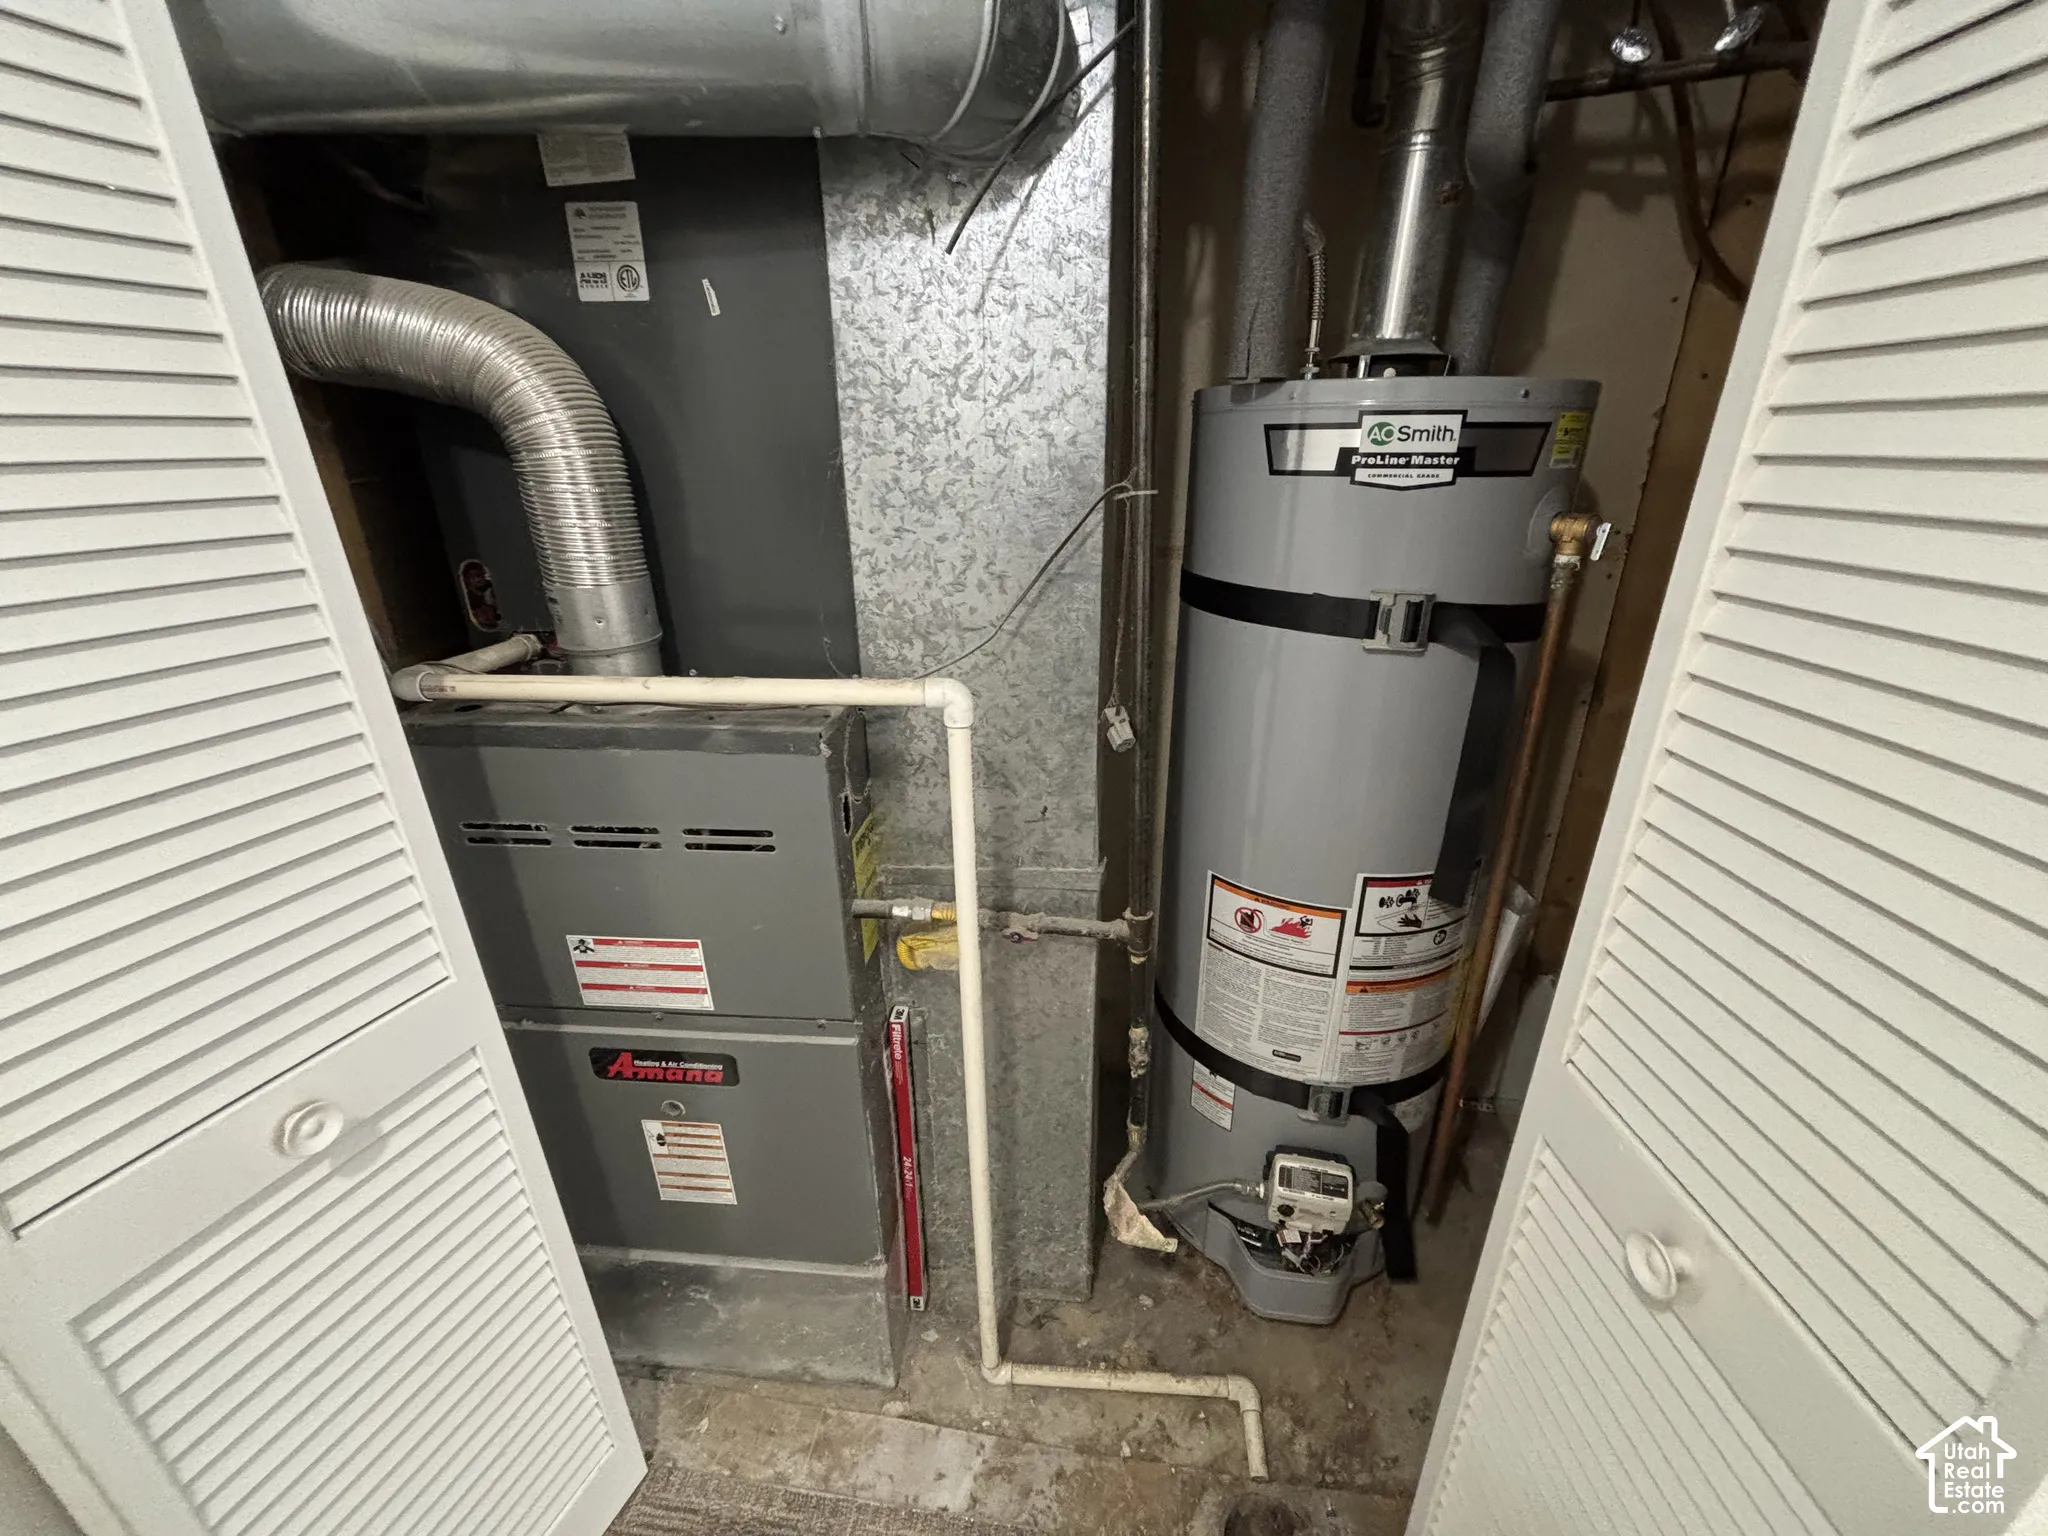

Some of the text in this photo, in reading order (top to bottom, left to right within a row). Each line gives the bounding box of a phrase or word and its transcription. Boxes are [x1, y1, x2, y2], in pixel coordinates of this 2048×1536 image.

[1351, 454, 1460, 465] ProLine Master
[893, 1008, 905, 1020] 3M
[891, 1023, 904, 1060] Filtrete
[607, 1051, 723, 1083] Amana
[680, 1062, 723, 1070] Conditioning
